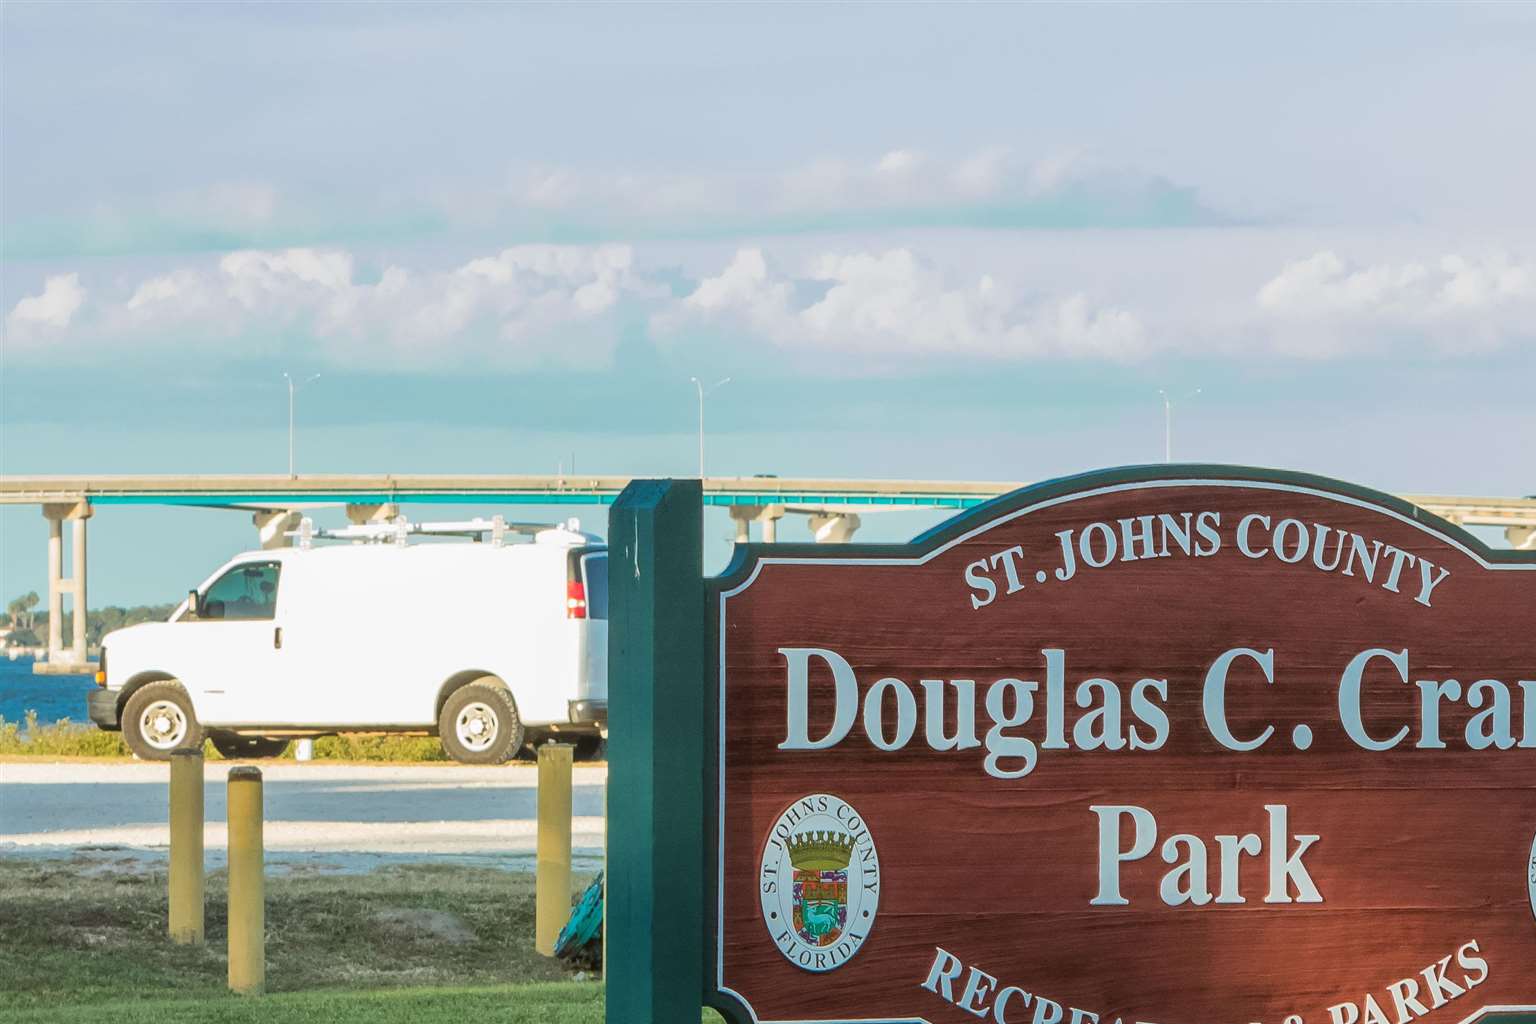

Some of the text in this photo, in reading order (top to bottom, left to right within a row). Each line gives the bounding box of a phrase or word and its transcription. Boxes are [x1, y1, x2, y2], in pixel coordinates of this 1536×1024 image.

[965, 511, 1450, 610] ST. JOHNS COUNTY
[777, 647, 1170, 779] Douglas
[1202, 647, 1313, 751] C.
[763, 796, 877, 895] ST. JOHNS COUNTY
[1089, 804, 1323, 906] Park
[776, 930, 863, 969] FLORIDA
